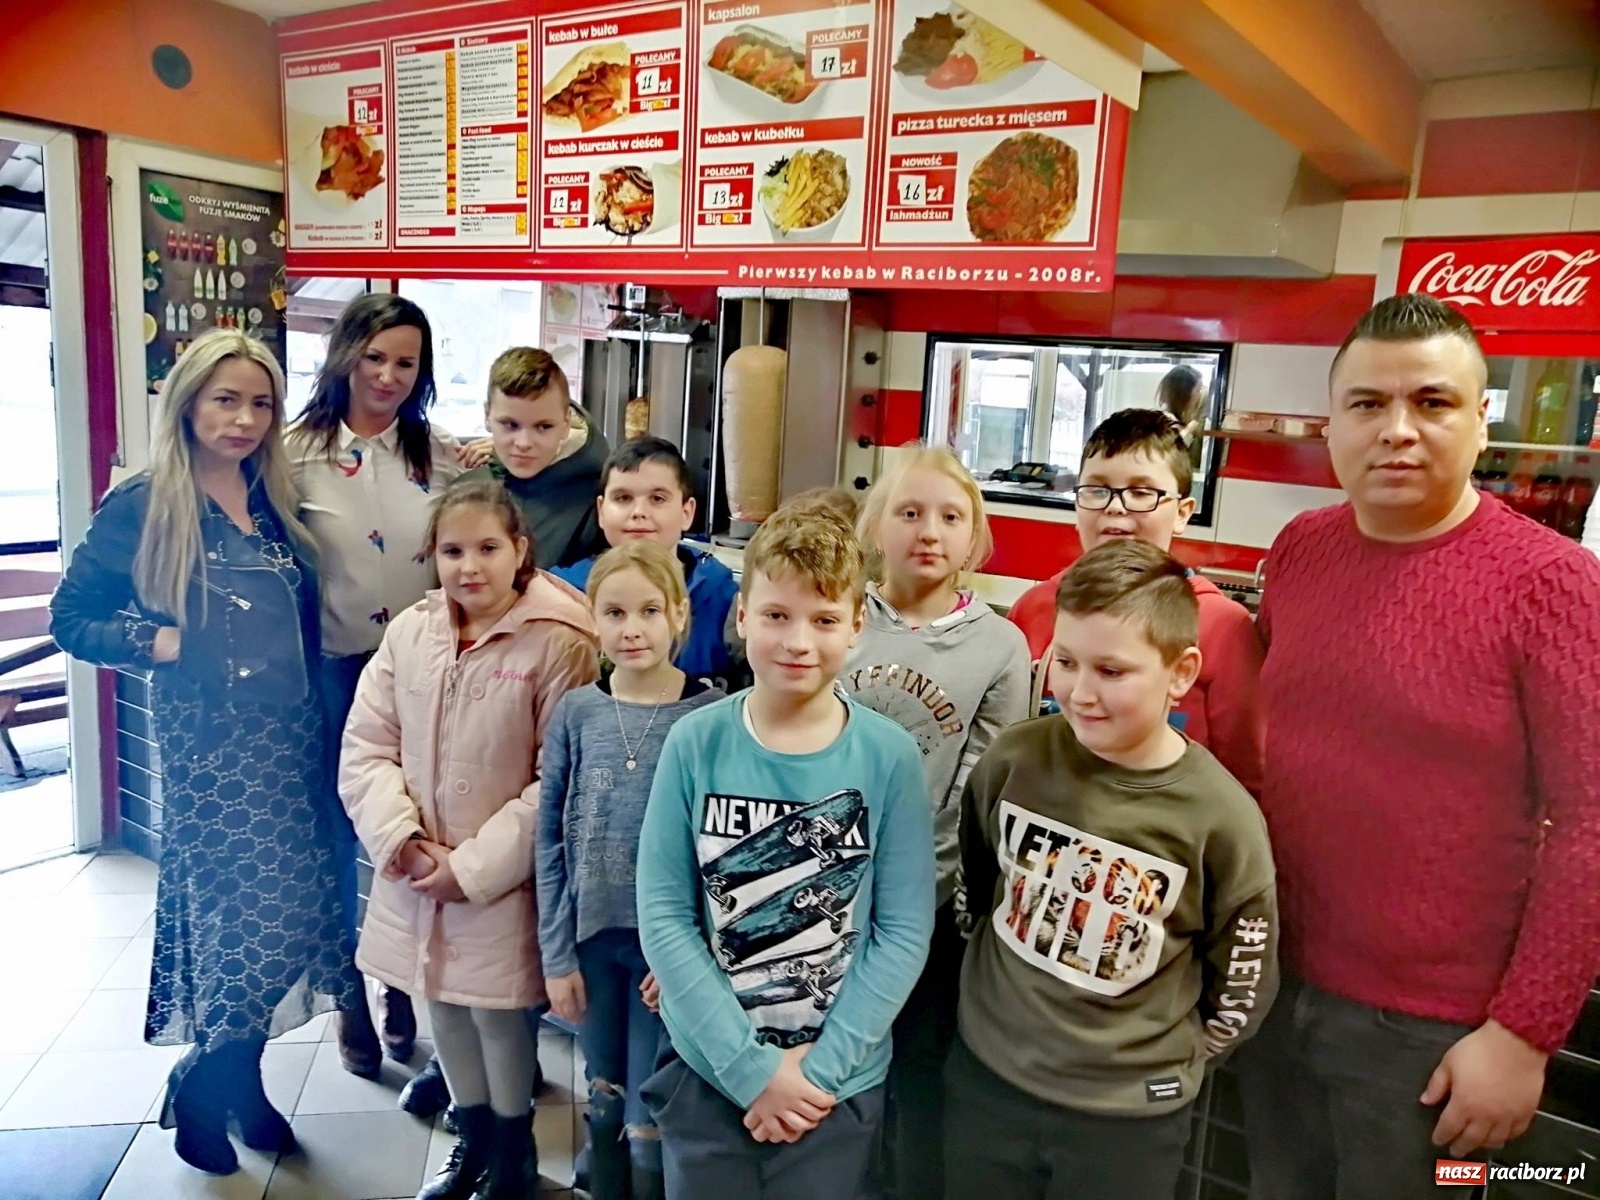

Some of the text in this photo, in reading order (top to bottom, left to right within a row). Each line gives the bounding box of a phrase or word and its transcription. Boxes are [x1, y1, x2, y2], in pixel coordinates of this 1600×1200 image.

[708, 4, 760, 22] kapsalon
[549, 23, 619, 43] kebab w bułce
[812, 29, 863, 44] POLECAMY
[635, 51, 676, 65] POLECAMY
[821, 56, 836, 73] 17
[842, 59, 857, 75] zł
[642, 74, 653, 91] 11
[660, 77, 672, 93] zł
[357, 106, 367, 120] 12
[640, 100, 653, 111] Big
[897, 109, 1068, 135] pizza turecka z mięsem
[704, 126, 805, 145] kebab w kubełku
[548, 135, 664, 154] kebab kurczak w cieście
[901, 155, 943, 167] NOWOŚĆ
[704, 166, 748, 176] POLECAMY
[549, 175, 585, 184] POLECAMY
[149, 193, 169, 205] fuze
[712, 190, 727, 205] 13
[730, 192, 744, 207] zł
[903, 183, 920, 200] 16
[927, 185, 944, 201] zł
[188, 195, 271, 216] ODKRYJ WYŚMIENITĄ
[552, 196, 564, 209] 12
[570, 199, 582, 213] zł
[223, 209, 261, 223] SMAKÓW
[705, 214, 721, 226] Big
[738, 265, 817, 282] Pierwszy
[821, 265, 877, 280] kebab
[882, 268, 896, 280] w
[901, 266, 1009, 282] Raciborzu
[1028, 267, 1101, 283] 2008r.
[1408, 249, 1600, 306] Coca-Cola
[849, 663, 964, 740] YFFINDOR
[704, 797, 778, 837] NEW
[1001, 813, 1103, 893] LET'S
